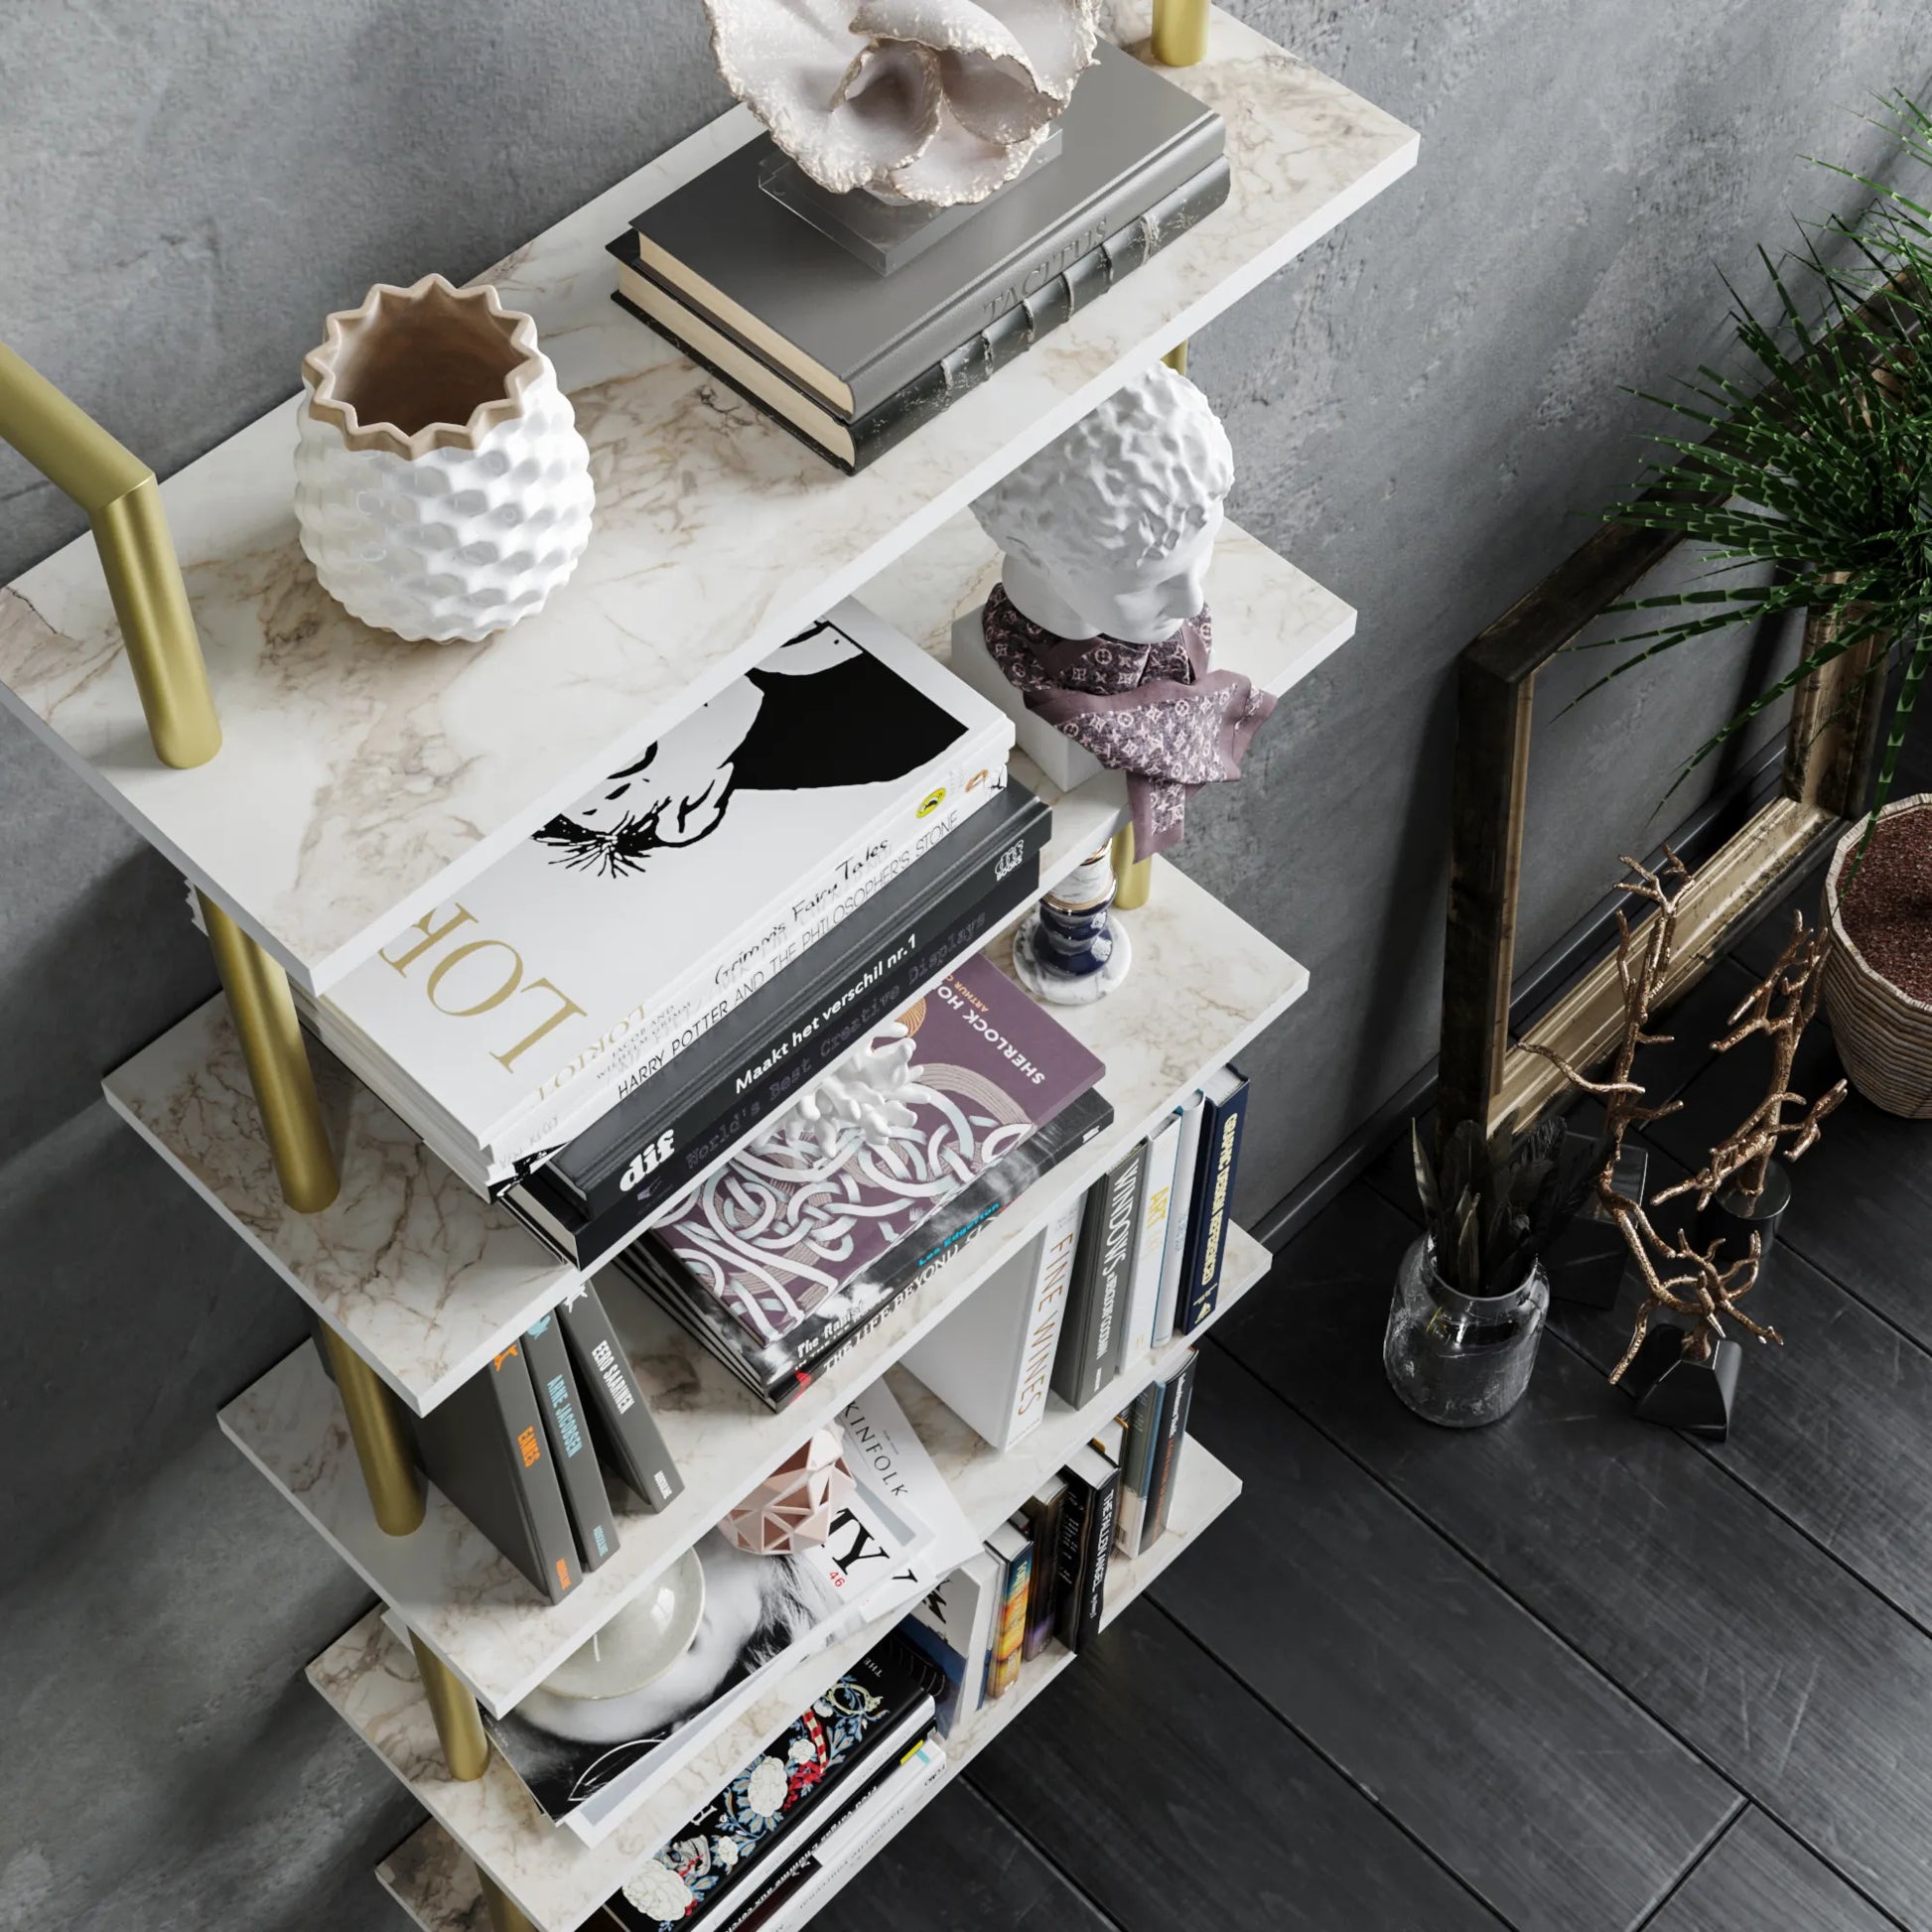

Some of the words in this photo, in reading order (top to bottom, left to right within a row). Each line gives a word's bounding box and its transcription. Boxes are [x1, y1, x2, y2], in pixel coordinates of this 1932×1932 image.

[836, 839, 889, 882] Tales
[618, 1050, 665, 1100] HARRY
[672, 1000, 729, 1052] POTTER
[735, 969, 765, 1006] AND
[769, 946, 797, 980] THE
[802, 849, 911, 954] PHILOSOPHER'S
[914, 810, 960, 856] STONE
[768, 1057, 813, 1104] Best
[820, 984, 901, 1059] Creative
[907, 910, 987, 986] Displays
[954, 980, 991, 1014] ARTHUR
[736, 1045, 789, 1095] Maakt
[792, 1018, 821, 1052] het
[822, 965, 885, 1031] verschil
[962, 1007, 1045, 1086] SHERLOCK
[620, 1129, 675, 1192] dif
[1103, 1159, 1139, 1278] WINDOWS
[1037, 1232, 1074, 1312] FINE
[592, 1339, 615, 1372] EERO
[797, 1335, 819, 1359] The
[1018, 1311, 1055, 1416] WINES
[603, 1363, 635, 1415] SAARINEN
[556, 1403, 583, 1458] JACOBSEN
[844, 1400, 908, 1496] KINFOLK
[829, 1571, 846, 1587] 46
[863, 1656, 884, 1678] THE
